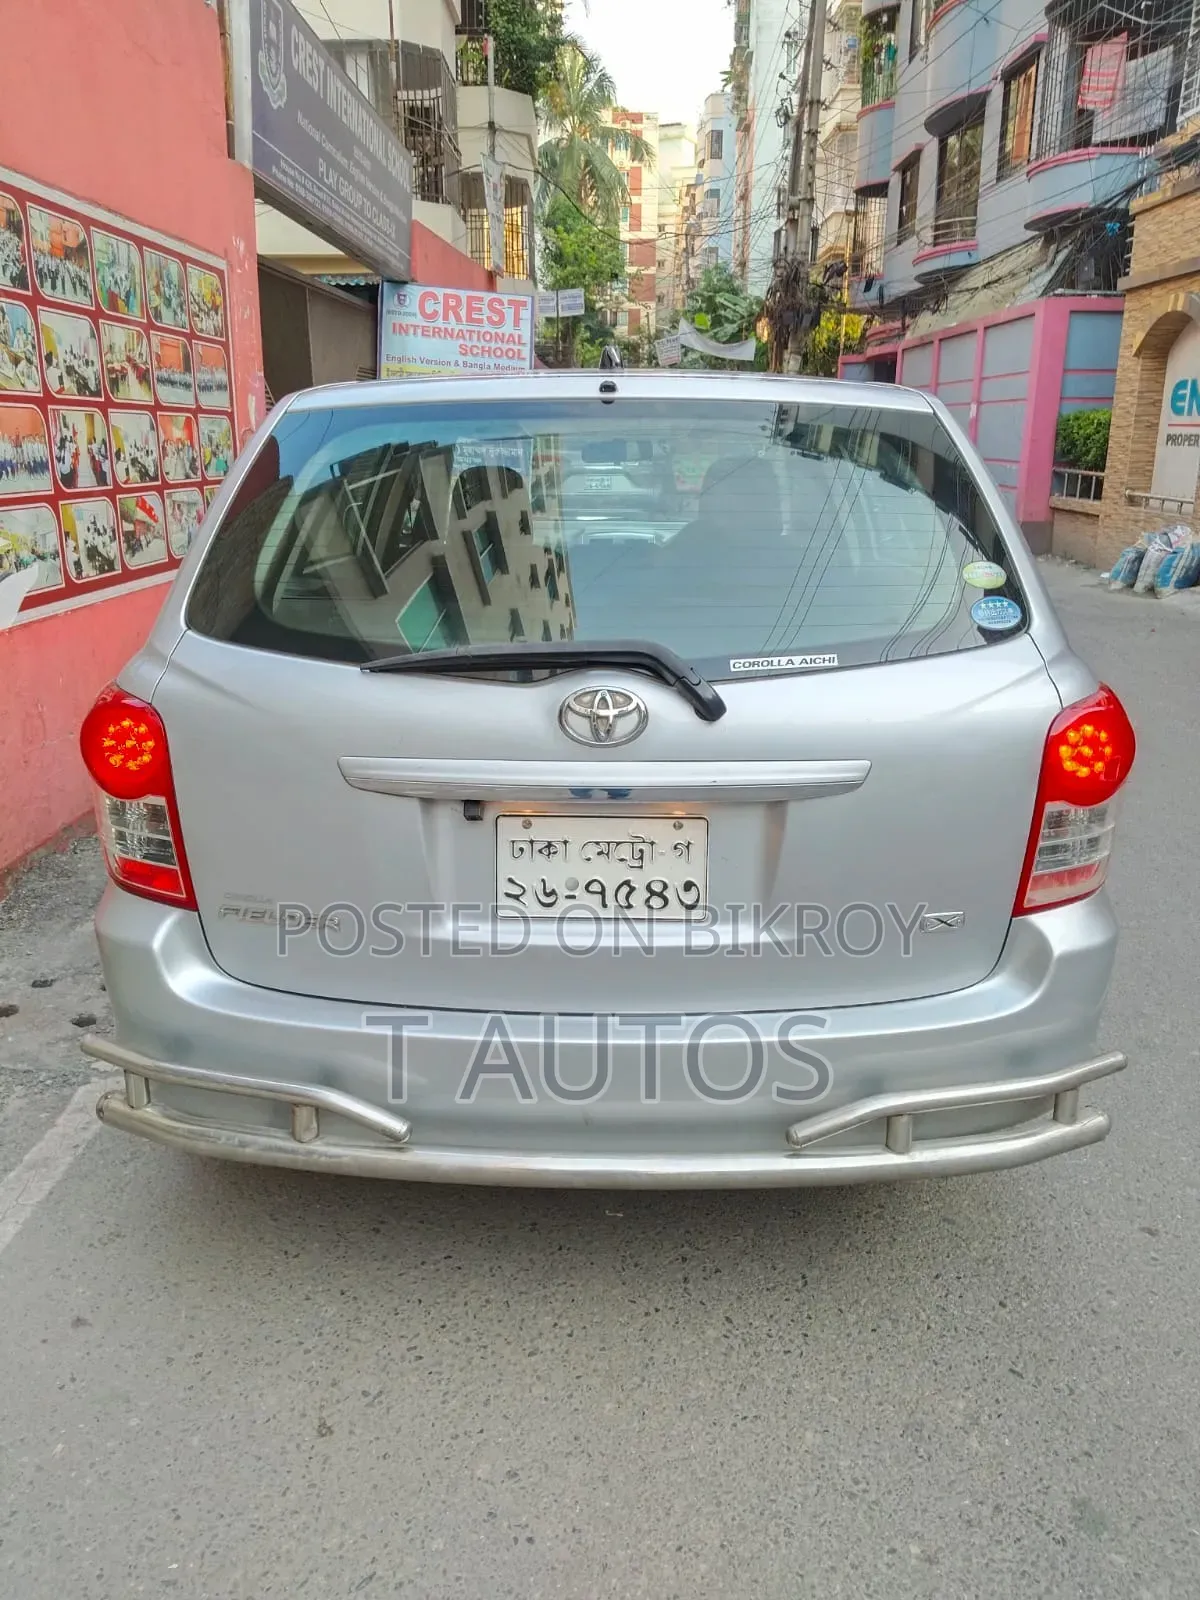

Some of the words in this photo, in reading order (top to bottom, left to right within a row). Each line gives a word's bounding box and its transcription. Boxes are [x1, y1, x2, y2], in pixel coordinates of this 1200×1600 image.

[291, 24, 325, 99] CREST
[326, 65, 387, 167] INTERNATIONAL
[297, 109, 321, 144] National
[318, 157, 338, 191] PLAY
[338, 176, 363, 209] GROUP
[363, 199, 372, 218] TO
[418, 290, 528, 330] CREST
[392, 321, 526, 346] INTERNATIONAL
[385, 354, 417, 364] English
[419, 357, 451, 367] Version
[454, 358, 460, 367] &
[462, 360, 491, 370] Bangla
[458, 343, 526, 361] SCHOOL
[732, 658, 796, 670] COROLLA
[799, 656, 836, 665] AICHI
[509, 836, 571, 863] ঢাকা
[503, 876, 702, 911] ২৬-৭৫৪৩
